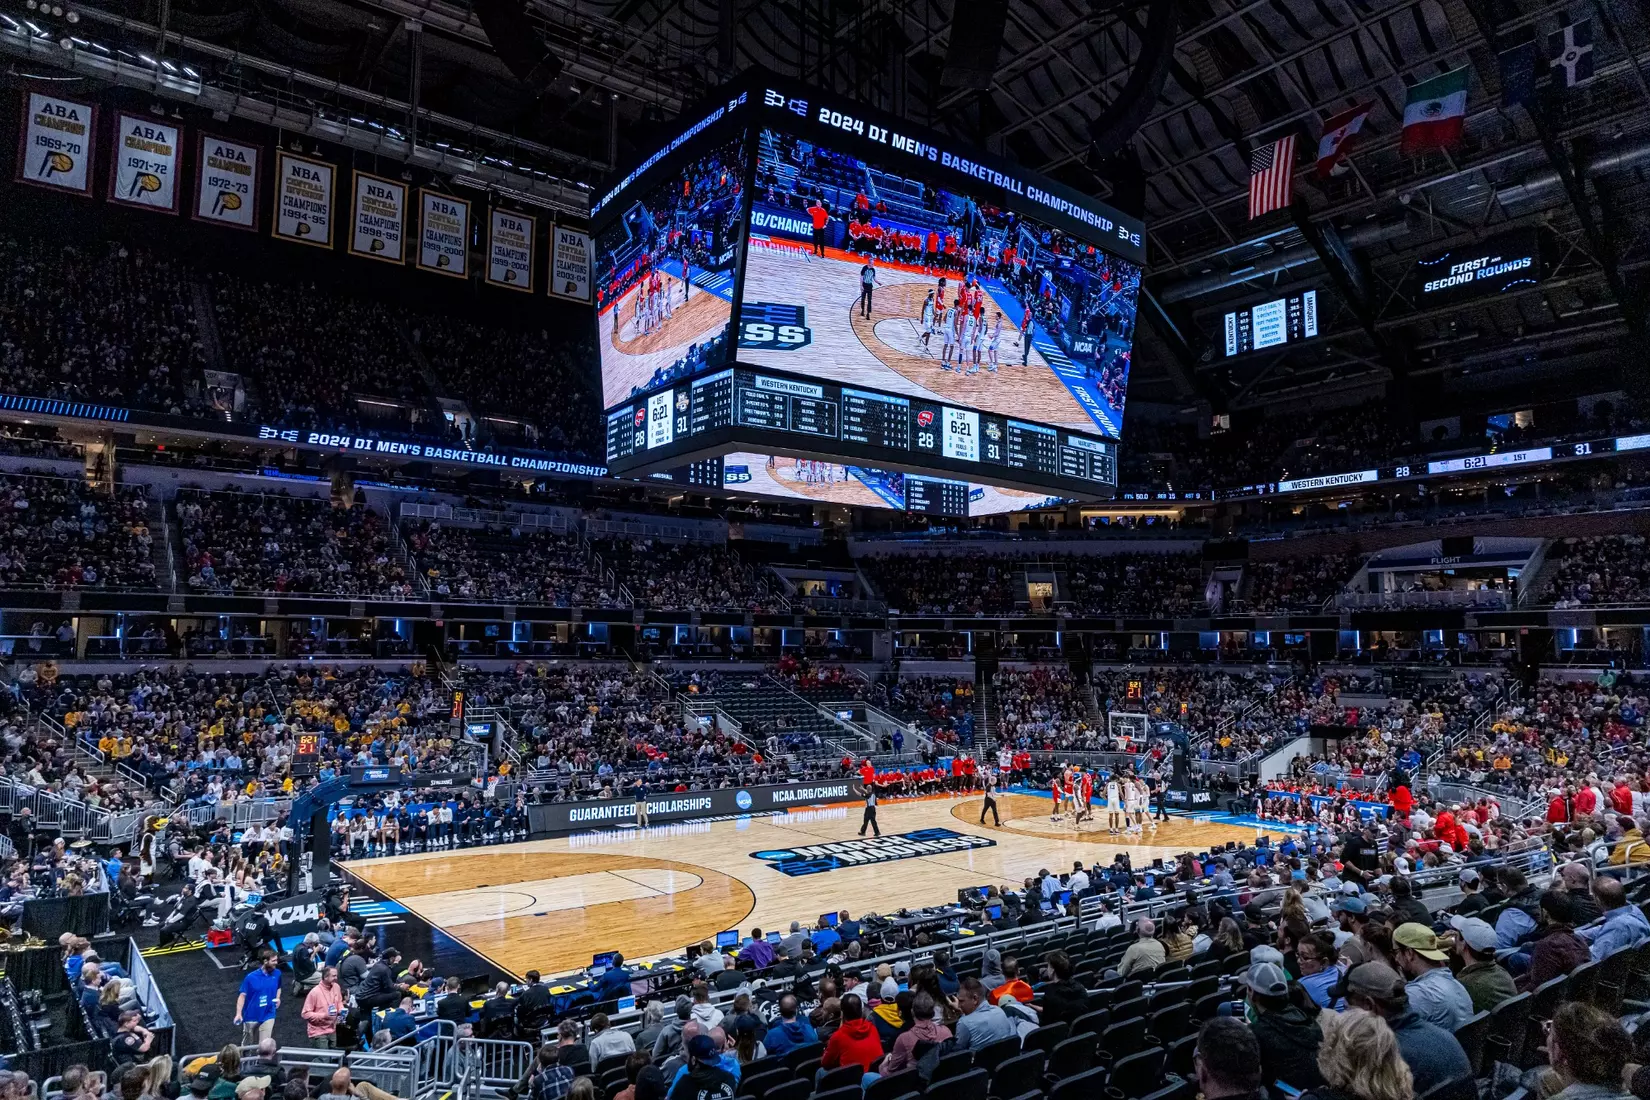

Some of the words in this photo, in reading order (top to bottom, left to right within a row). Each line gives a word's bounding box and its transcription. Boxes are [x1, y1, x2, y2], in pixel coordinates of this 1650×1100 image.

[41, 103, 79, 121] ABA
[131, 125, 166, 143] ABA
[35, 135, 80, 154] 1969-70
[213, 146, 246, 163] ABA
[601, 190, 614, 207] 2024
[614, 184, 621, 196] DI
[620, 171, 636, 190] MEN'S
[636, 144, 670, 177] BASKETBALL
[671, 107, 725, 150] CHAMPIONSHIP
[127, 157, 167, 175] 1971-72
[291, 165, 321, 182] NBA
[819, 107, 864, 135] 2024
[868, 124, 888, 143] DI
[892, 133, 938, 161] MEN'S
[941, 151, 1024, 195] BASKETBALL
[1026, 186, 1113, 232] CHAMPIONSHIP
[208, 176, 248, 194] 1972-73
[367, 184, 394, 200] NBA
[283, 195, 327, 214] CHAMPIONS
[432, 201, 458, 216] NBA
[282, 208, 326, 226] 1994-95
[359, 213, 400, 232] CHAMPIONS
[501, 217, 523, 232] NBA
[358, 225, 399, 241] 1998-99
[426, 229, 462, 247] CHAMPIONS
[560, 233, 584, 248] NBA
[423, 241, 464, 257] 1999-2000
[494, 245, 528, 262] CHAMPIONS
[492, 257, 529, 272] 1999-2000
[557, 259, 587, 275] CHAMPIONS
[1451, 256, 1489, 275] FIRST
[556, 270, 587, 283] 2003-04
[1424, 272, 1474, 292] SECOND
[1476, 256, 1532, 280] ROUNDS
[1307, 297, 1315, 331] MARQUETTE
[740, 322, 805, 343] SS
[1074, 341, 1096, 353] NCAA
[761, 379, 788, 390] WESTERN
[788, 383, 818, 395] KENTUCKY
[1072, 385, 1094, 413] FIRST
[652, 404, 668, 422] 6:21
[956, 411, 966, 420] 1ST
[676, 416, 688, 434] 31
[950, 420, 972, 436] 6:21
[635, 430, 645, 447] 28
[918, 432, 934, 448] 28
[308, 433, 350, 448] 2024
[354, 438, 373, 450] DI
[376, 440, 421, 455] MEN'S
[424, 446, 508, 466] BASKETBALL
[511, 457, 608, 477] CHAMPIONSHIP
[987, 444, 1000, 460] 31
[1513, 453, 1527, 462] 1ST
[1575, 443, 1592, 455] 31
[1463, 456, 1488, 469] 6:21
[1395, 466, 1410, 477] 28
[1291, 477, 1324, 490] WESTERN
[1325, 473, 1363, 485] KENTUCKY
[1431, 556, 1461, 565] FLIGHT
[1127, 687, 1141, 698] 21
[299, 743, 314, 754] 21
[772, 785, 848, 803] NCAA.ORG/CHANGE
[1192, 792, 1211, 803] NCAA
[569, 803, 636, 822] GUARANTEED
[647, 797, 712, 814] CHOLARSHIPS
[790, 834, 912, 857] MARCH
[836, 835, 984, 863] MADNESS
[264, 903, 319, 926] NCAA
